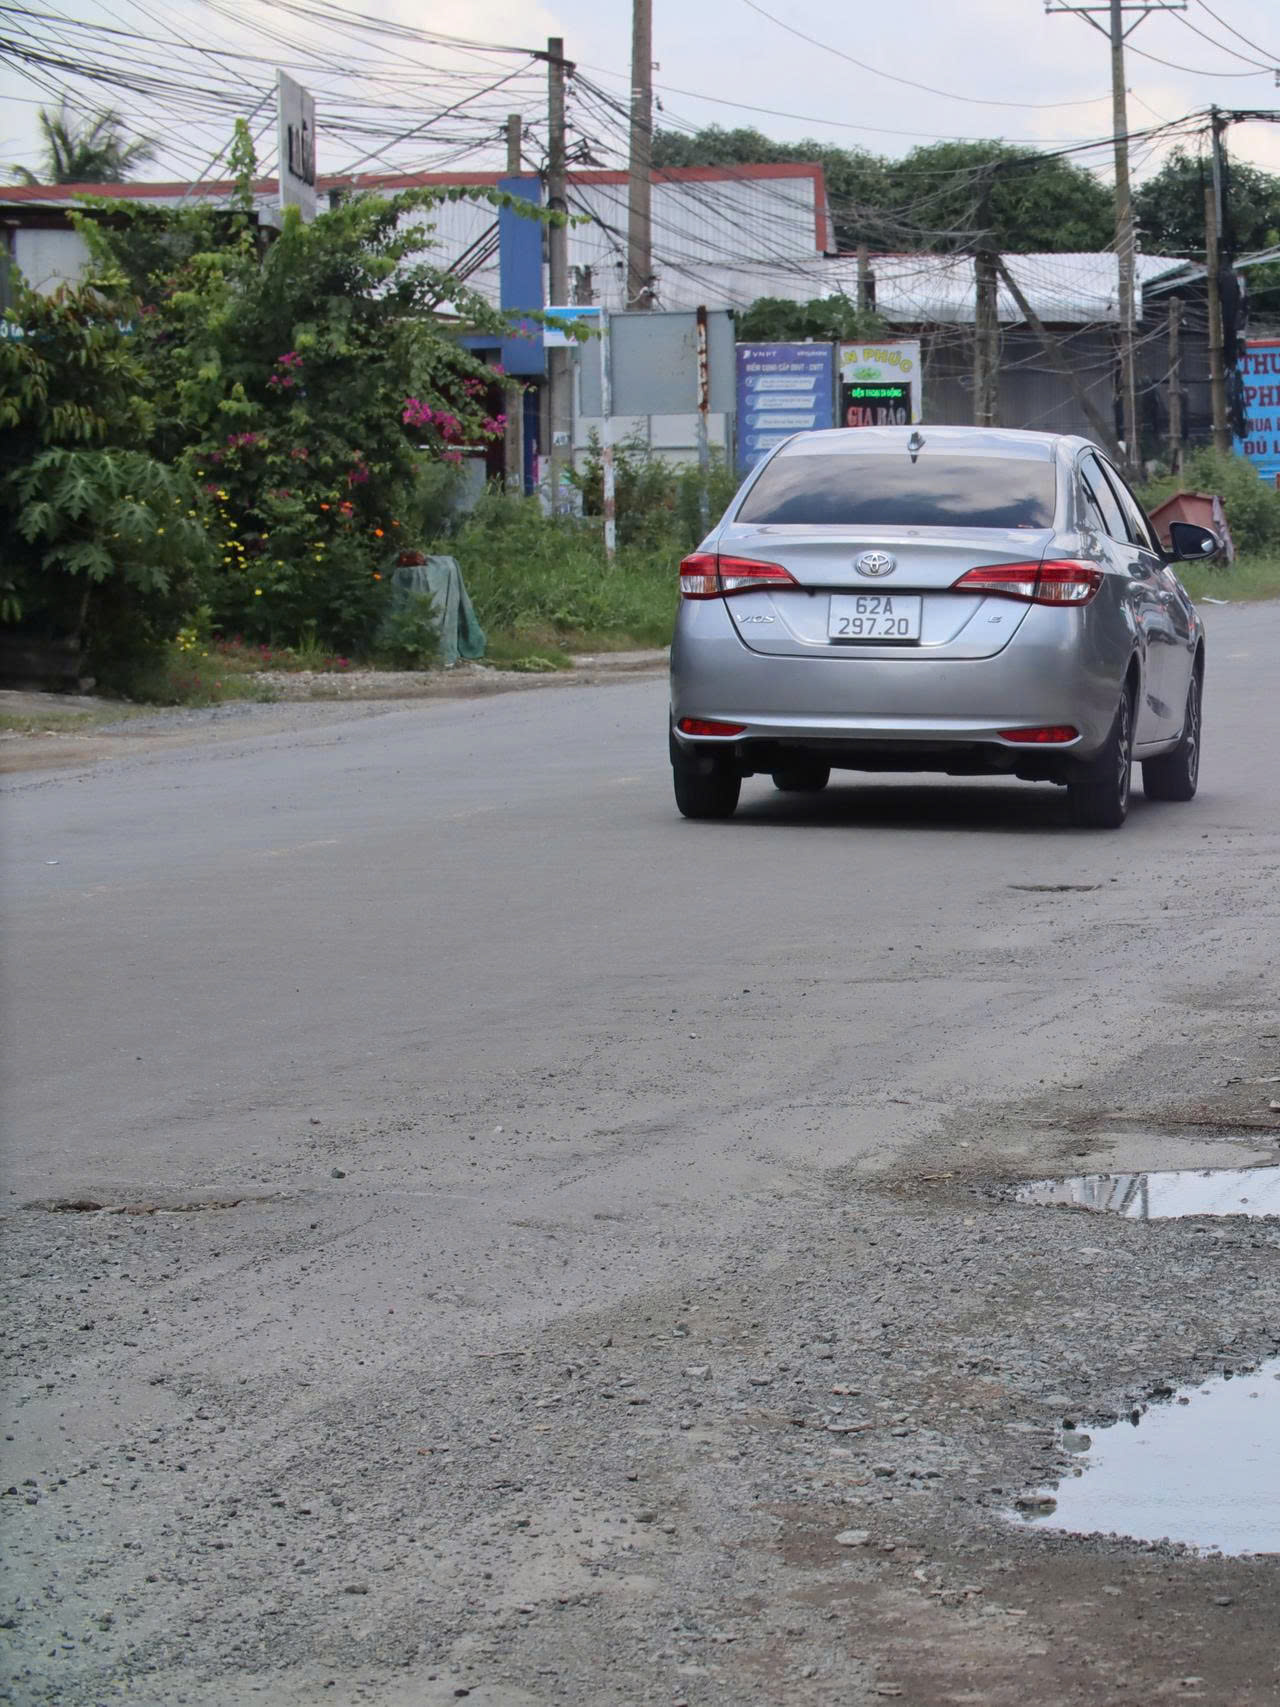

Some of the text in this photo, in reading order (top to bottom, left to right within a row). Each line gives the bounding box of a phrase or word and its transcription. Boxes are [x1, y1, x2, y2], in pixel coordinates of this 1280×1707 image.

[847, 406, 873, 426] GIA
[856, 597, 893, 615] 62A
[838, 618, 909, 636] 297.20
